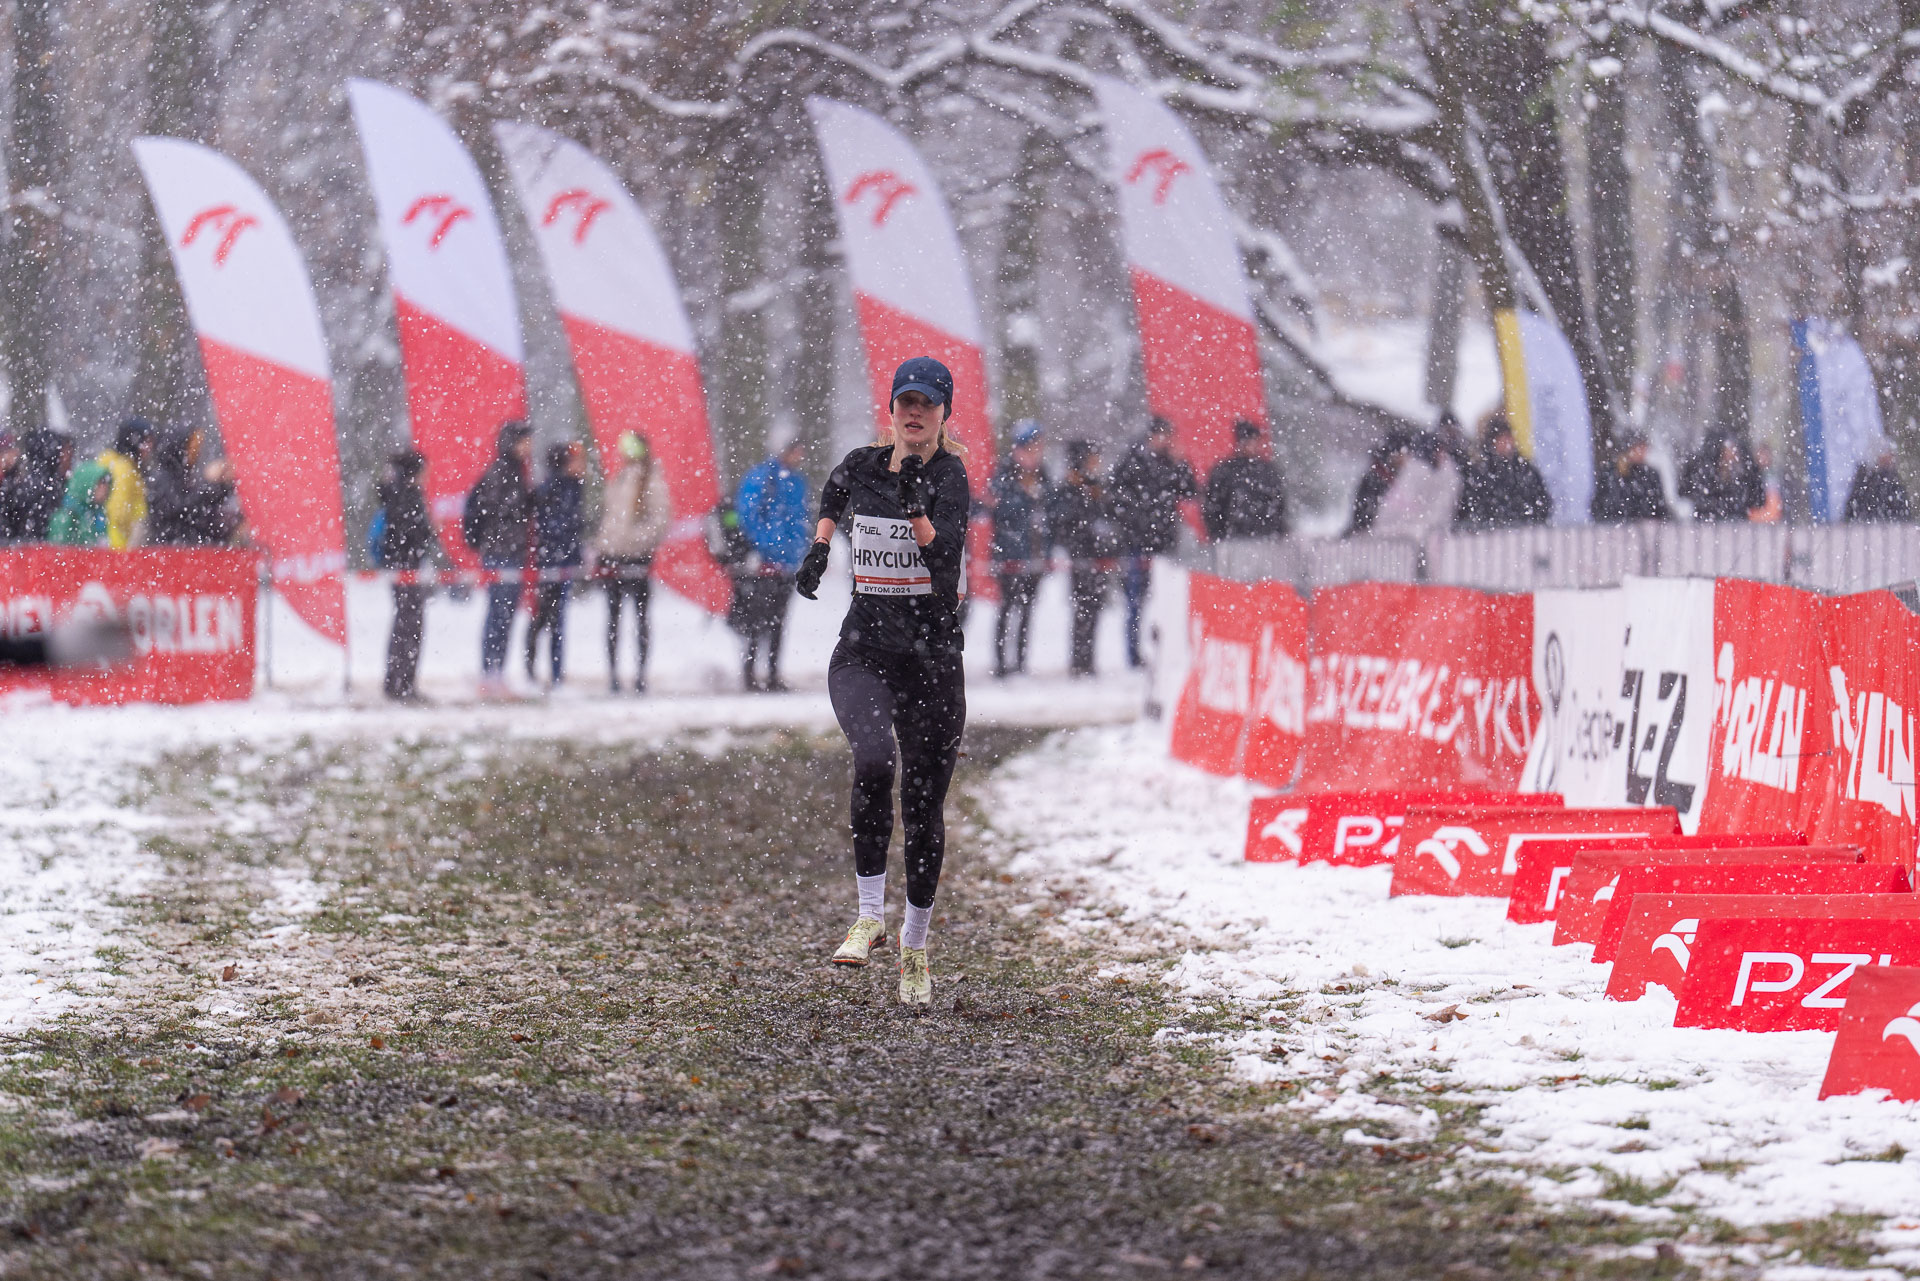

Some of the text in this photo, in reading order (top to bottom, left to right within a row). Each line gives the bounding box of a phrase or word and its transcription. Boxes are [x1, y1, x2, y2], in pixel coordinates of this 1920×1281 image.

[853, 548, 927, 569] HRYCIUK
[864, 585, 890, 594] BYTOM
[128, 594, 243, 655] ORLEN
[1730, 951, 1892, 1009] PZ
